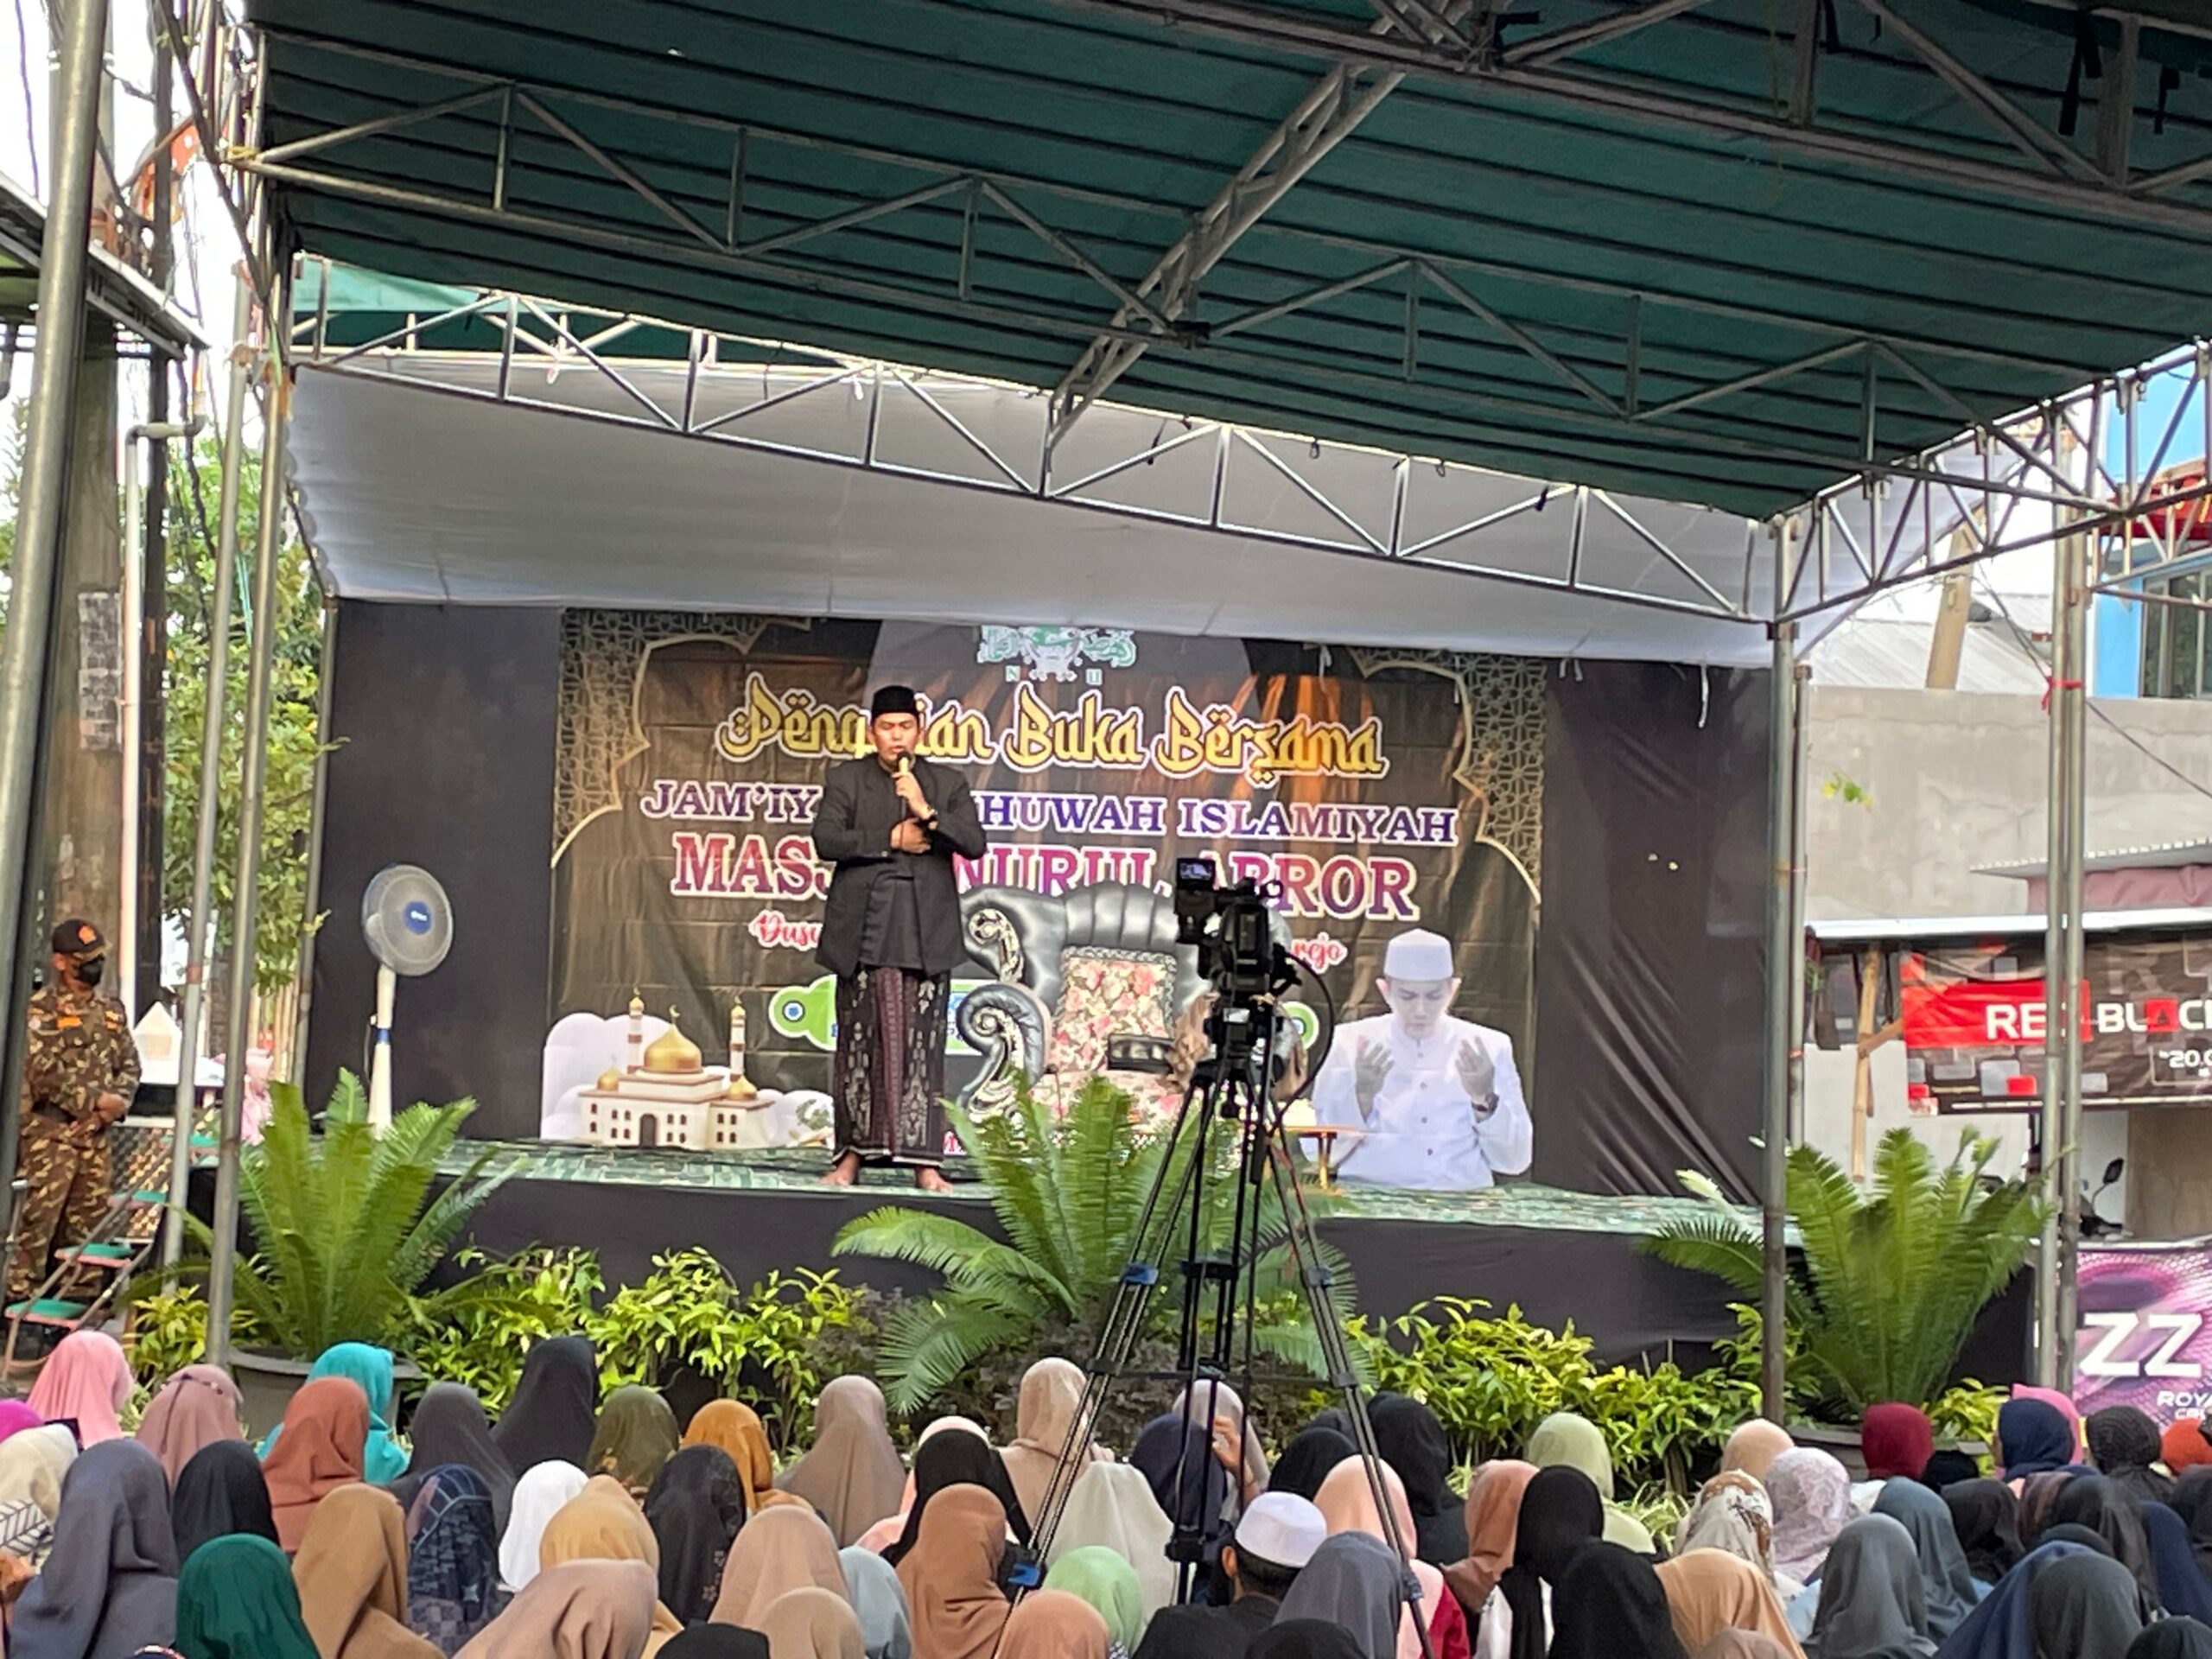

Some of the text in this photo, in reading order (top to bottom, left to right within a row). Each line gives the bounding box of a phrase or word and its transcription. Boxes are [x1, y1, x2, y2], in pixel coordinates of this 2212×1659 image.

[1002, 682, 1149, 770] Buka
[642, 781, 1458, 844] JAM'IY HUWAH ISLAMIYAH
[1986, 1002, 2066, 1040] RE
